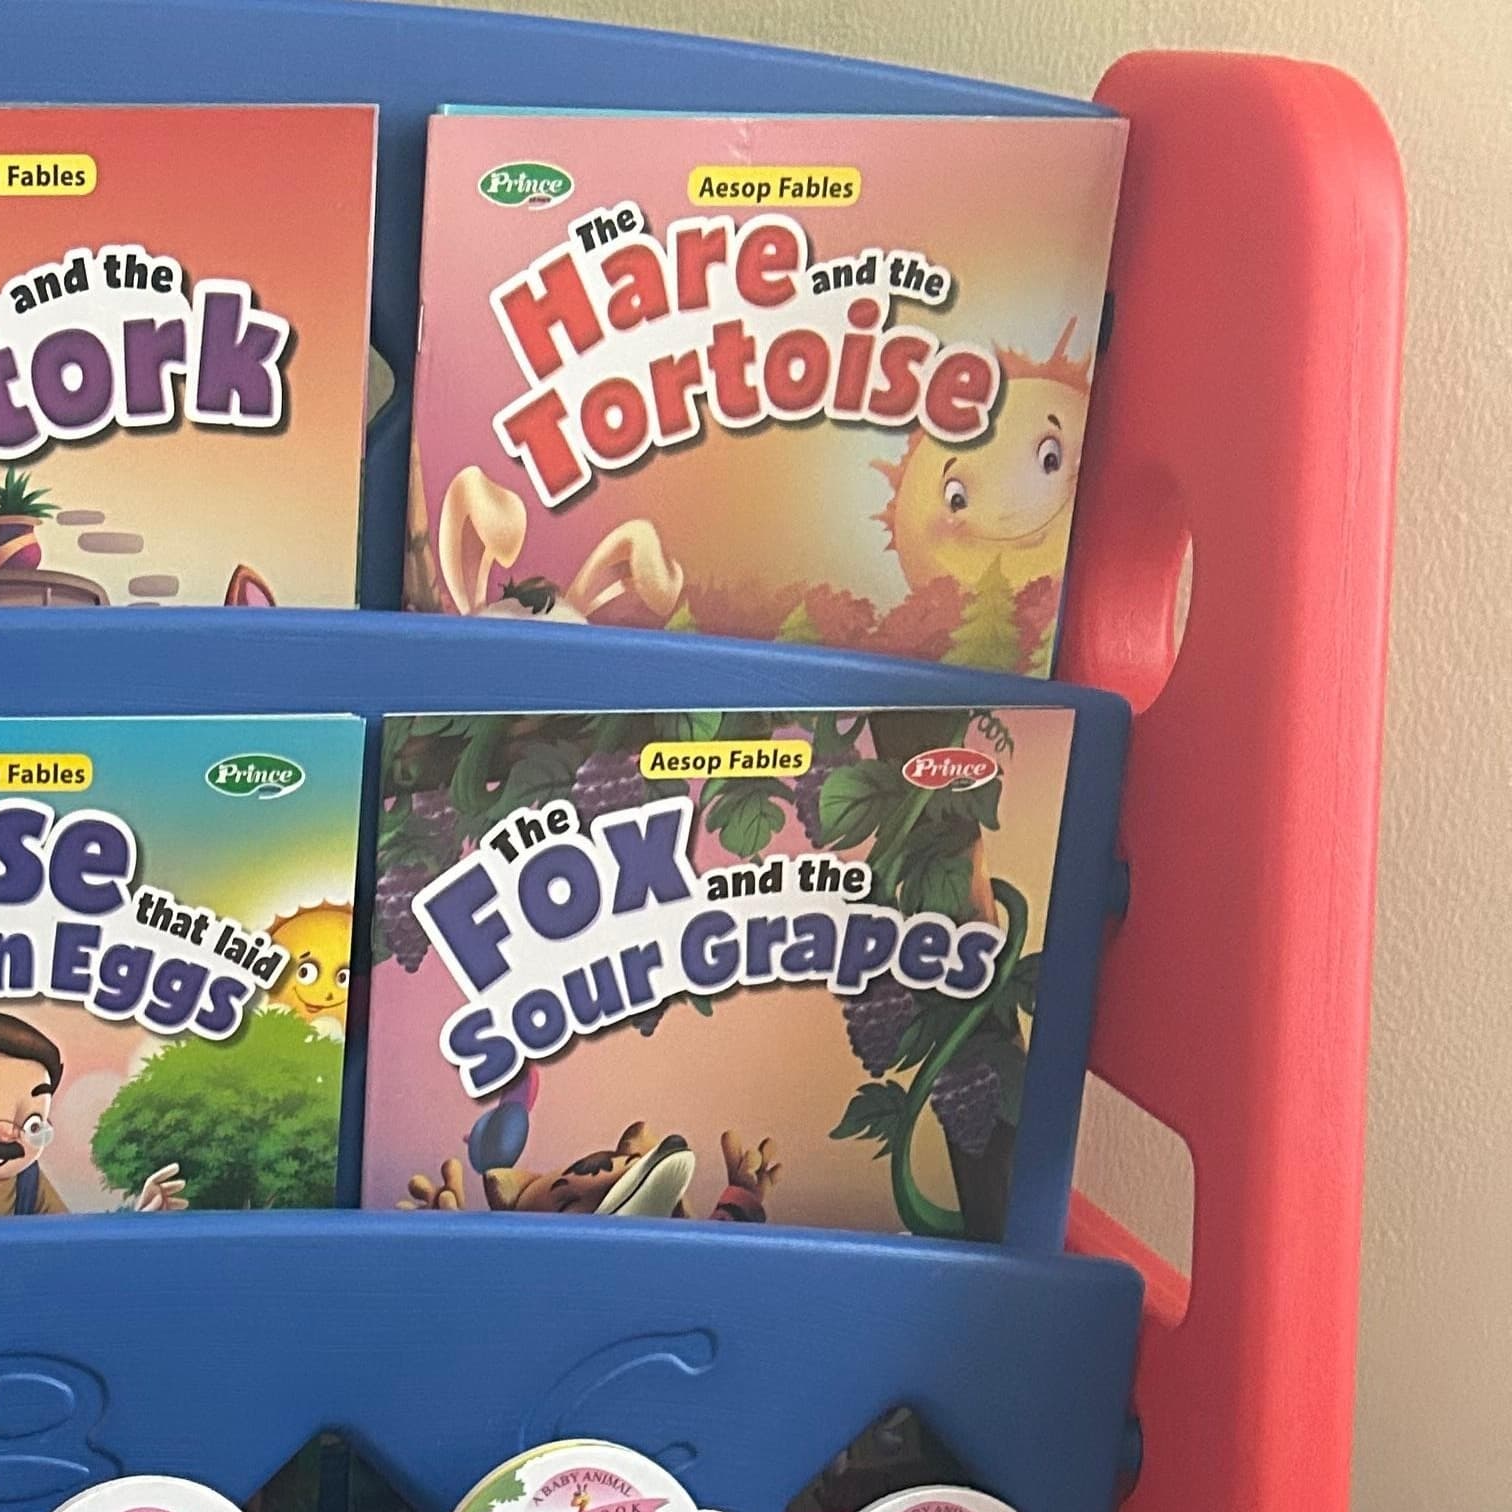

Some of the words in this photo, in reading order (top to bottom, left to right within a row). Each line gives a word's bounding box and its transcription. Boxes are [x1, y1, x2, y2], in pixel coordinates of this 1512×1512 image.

[7, 164, 86, 188] Fables
[487, 171, 563, 194] Prince
[699, 176, 771, 202] Aesop
[778, 177, 855, 201] Fables
[575, 206, 637, 252] The
[10, 256, 90, 314] and
[103, 254, 174, 293] the
[499, 223, 800, 379] Hare
[811, 256, 877, 295] and
[889, 257, 945, 297] the
[503, 297, 995, 498] Tortoise
[7, 764, 86, 786] Fables
[216, 762, 293, 787] Prince
[651, 751, 722, 774] Aesop
[729, 748, 804, 772] Fables
[911, 758, 987, 778] Prince
[489, 808, 571, 863] The
[425, 809, 691, 993] Fox
[707, 863, 784, 901] and
[797, 860, 865, 893] the
[137, 892, 210, 947] that
[215, 924, 282, 983] laid
[50, 922, 253, 1036] Eggs
[449, 939, 662, 1089] Sour
[680, 909, 1000, 991] Grapes
[541, 1472, 579, 1497] BABY
[582, 1472, 633, 1497] ANIMAL
